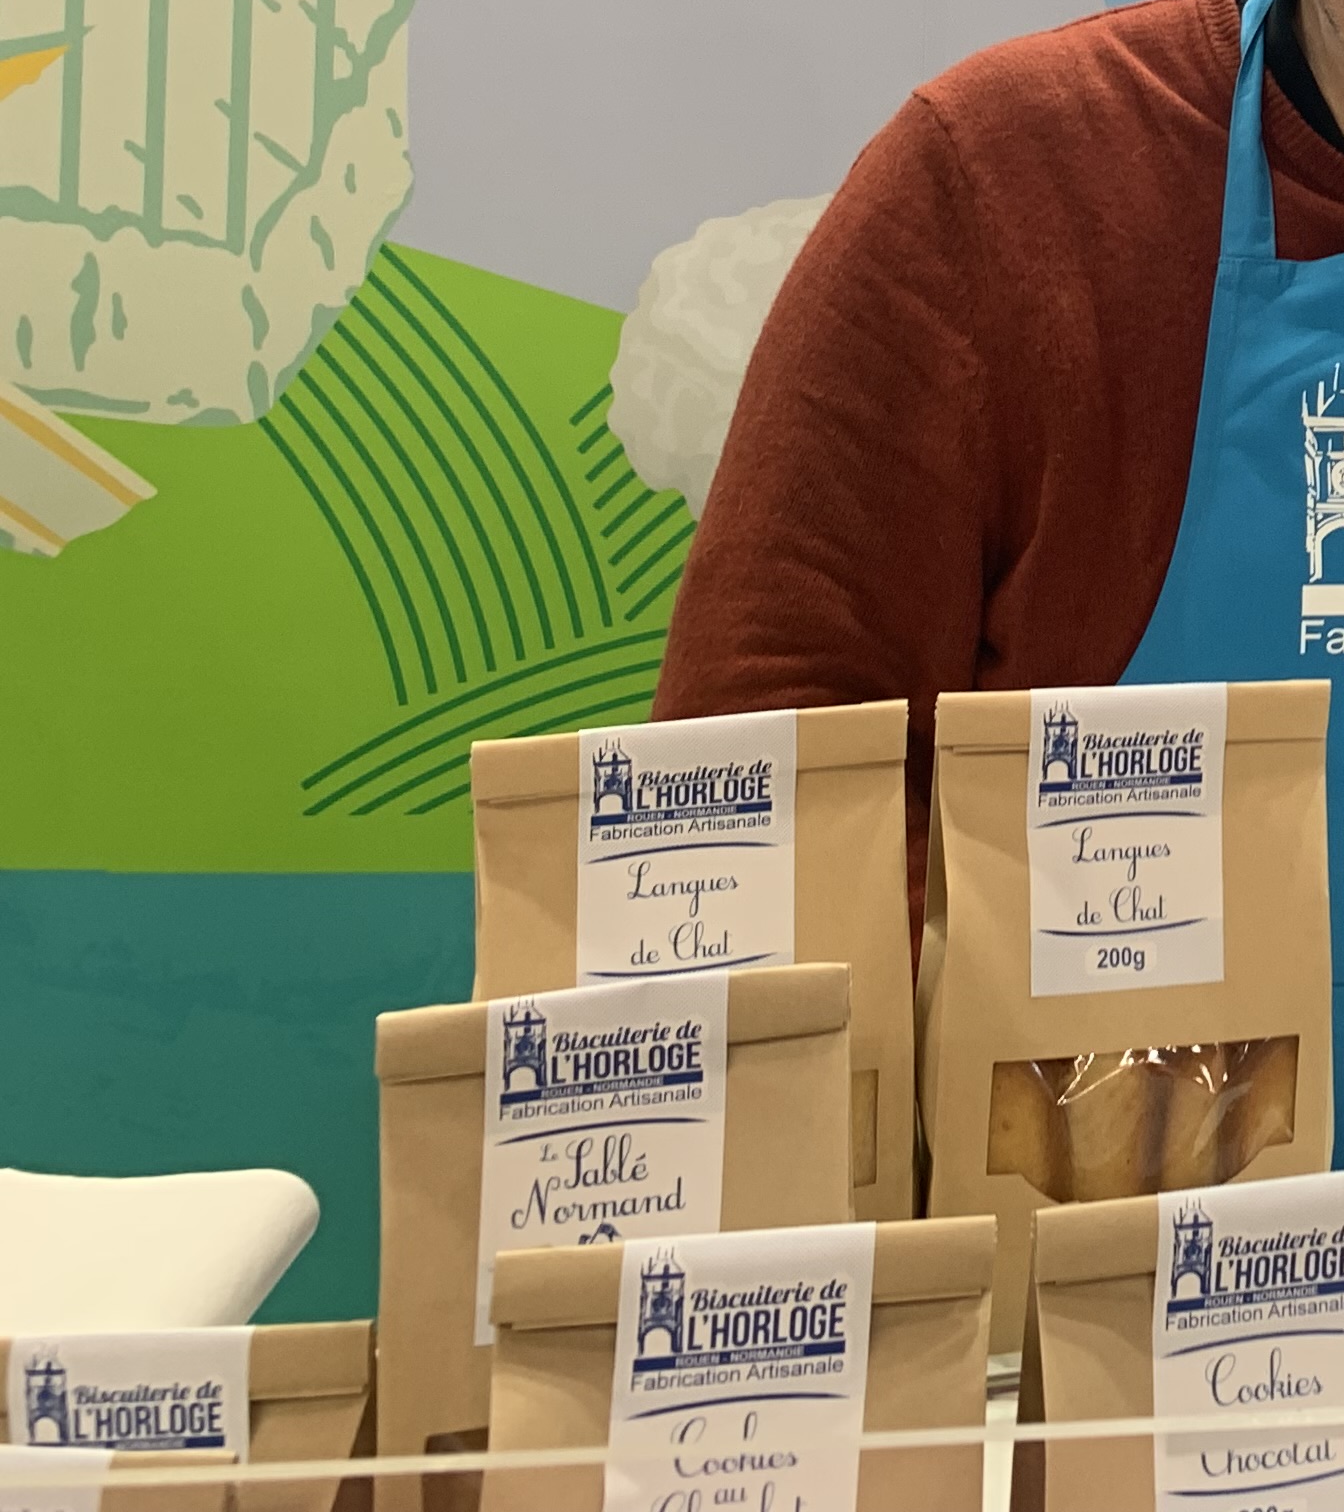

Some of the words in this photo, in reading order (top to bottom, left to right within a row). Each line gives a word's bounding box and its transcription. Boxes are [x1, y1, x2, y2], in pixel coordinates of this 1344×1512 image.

[1082, 732, 1178, 751] Biscuiterie
[1183, 728, 1204, 744] de
[637, 763, 746, 787] Biscuiterie
[748, 759, 772, 777] de
[1081, 745, 1203, 779] L'HORLOGE
[635, 775, 772, 810] L'HORLOGE
[1037, 789, 1123, 808] Fabrication
[1126, 786, 1202, 802] Artisanale
[589, 820, 684, 842] Fabrication
[688, 813, 772, 832] Artisanale
[627, 809, 665, 822] ROUEN
[673, 805, 738, 819] NORMANDIE
[1072, 827, 1171, 881] Langues
[627, 861, 739, 918] Langues
[1076, 901, 1102, 926] de
[1109, 886, 1167, 921] Chat
[630, 939, 660, 966] de
[668, 922, 733, 957] Chat
[1096, 948, 1146, 971] 200g
[552, 1022, 671, 1053] Biscuiterie
[676, 1020, 702, 1040] de
[551, 1041, 702, 1085] L'HORLOGE
[500, 1097, 604, 1121] Fabrication
[609, 1085, 702, 1109] Artisanale
[541, 1085, 583, 1099] ROUEN
[593, 1076, 664, 1092] NORMANDIE
[563, 1133, 649, 1190] Sablé
[511, 1176, 687, 1230] Normand
[1218, 1228, 1327, 1258] Biscuiterie
[690, 1281, 815, 1312] Biscuiterie
[820, 1278, 848, 1299] de
[687, 1302, 846, 1351] L'HORLOGE
[1165, 1306, 1263, 1332] Fabrication
[675, 1352, 720, 1367] ROUEN
[730, 1346, 804, 1363] NORMANDIE
[630, 1367, 741, 1392] Fabrication
[746, 1356, 844, 1380] Artisanale
[1204, 1346, 1324, 1407] Cookies
[72, 1383, 190, 1405] Biscuiterie
[196, 1381, 223, 1400] de
[73, 1402, 224, 1439] L'HORLOGE
